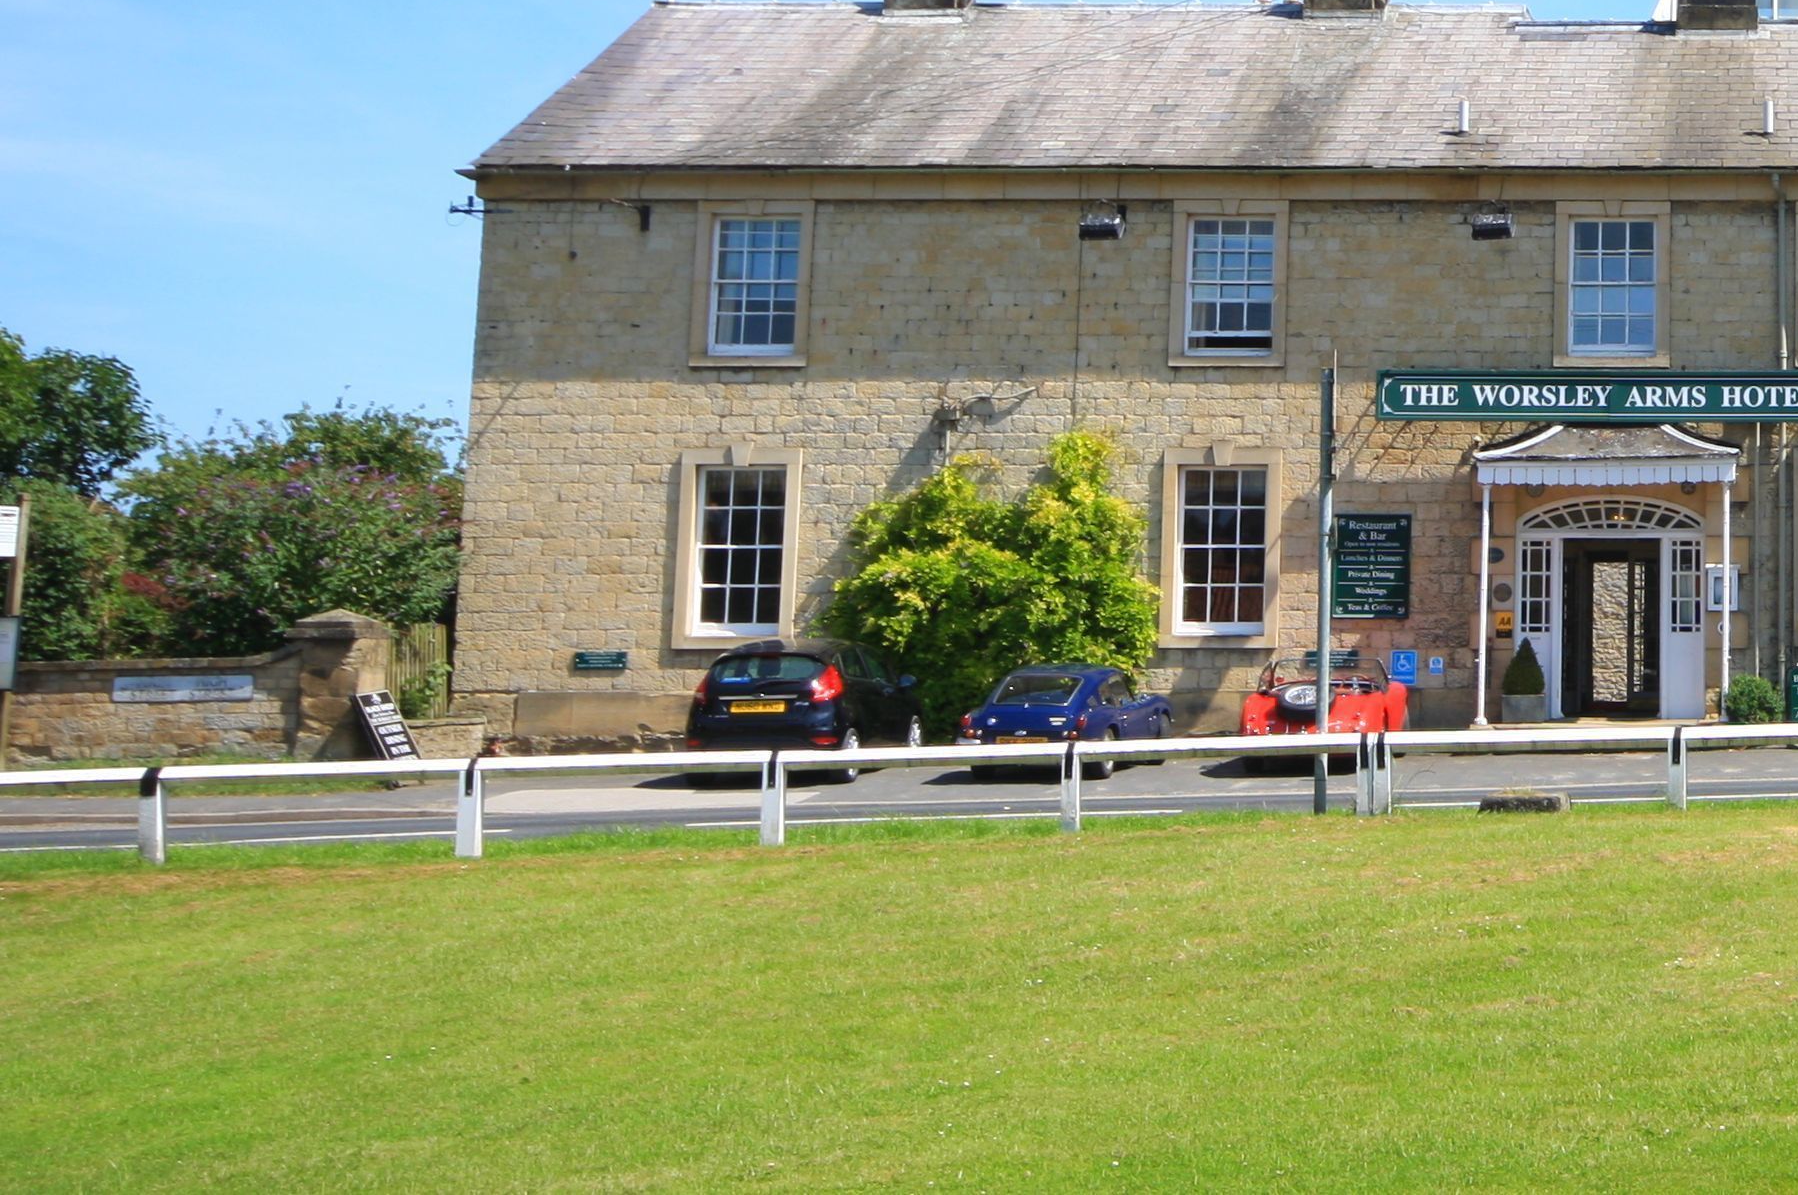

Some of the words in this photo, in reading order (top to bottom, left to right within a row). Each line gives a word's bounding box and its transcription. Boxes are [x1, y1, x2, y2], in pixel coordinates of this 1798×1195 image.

[1400, 384, 1459, 406] THE
[1472, 384, 1613, 407] WORSLEY
[1625, 385, 1707, 408] ARMS
[1349, 520, 1397, 530] Restaurant
[1359, 531, 1367, 540] &
[1370, 531, 1386, 540] Bar
[1341, 554, 1368, 562] Lunches
[1377, 554, 1403, 562] Dinners
[1372, 571, 1395, 579] Dining
[1354, 587, 1388, 596] Weddings
[1498, 616, 1511, 626] AA
